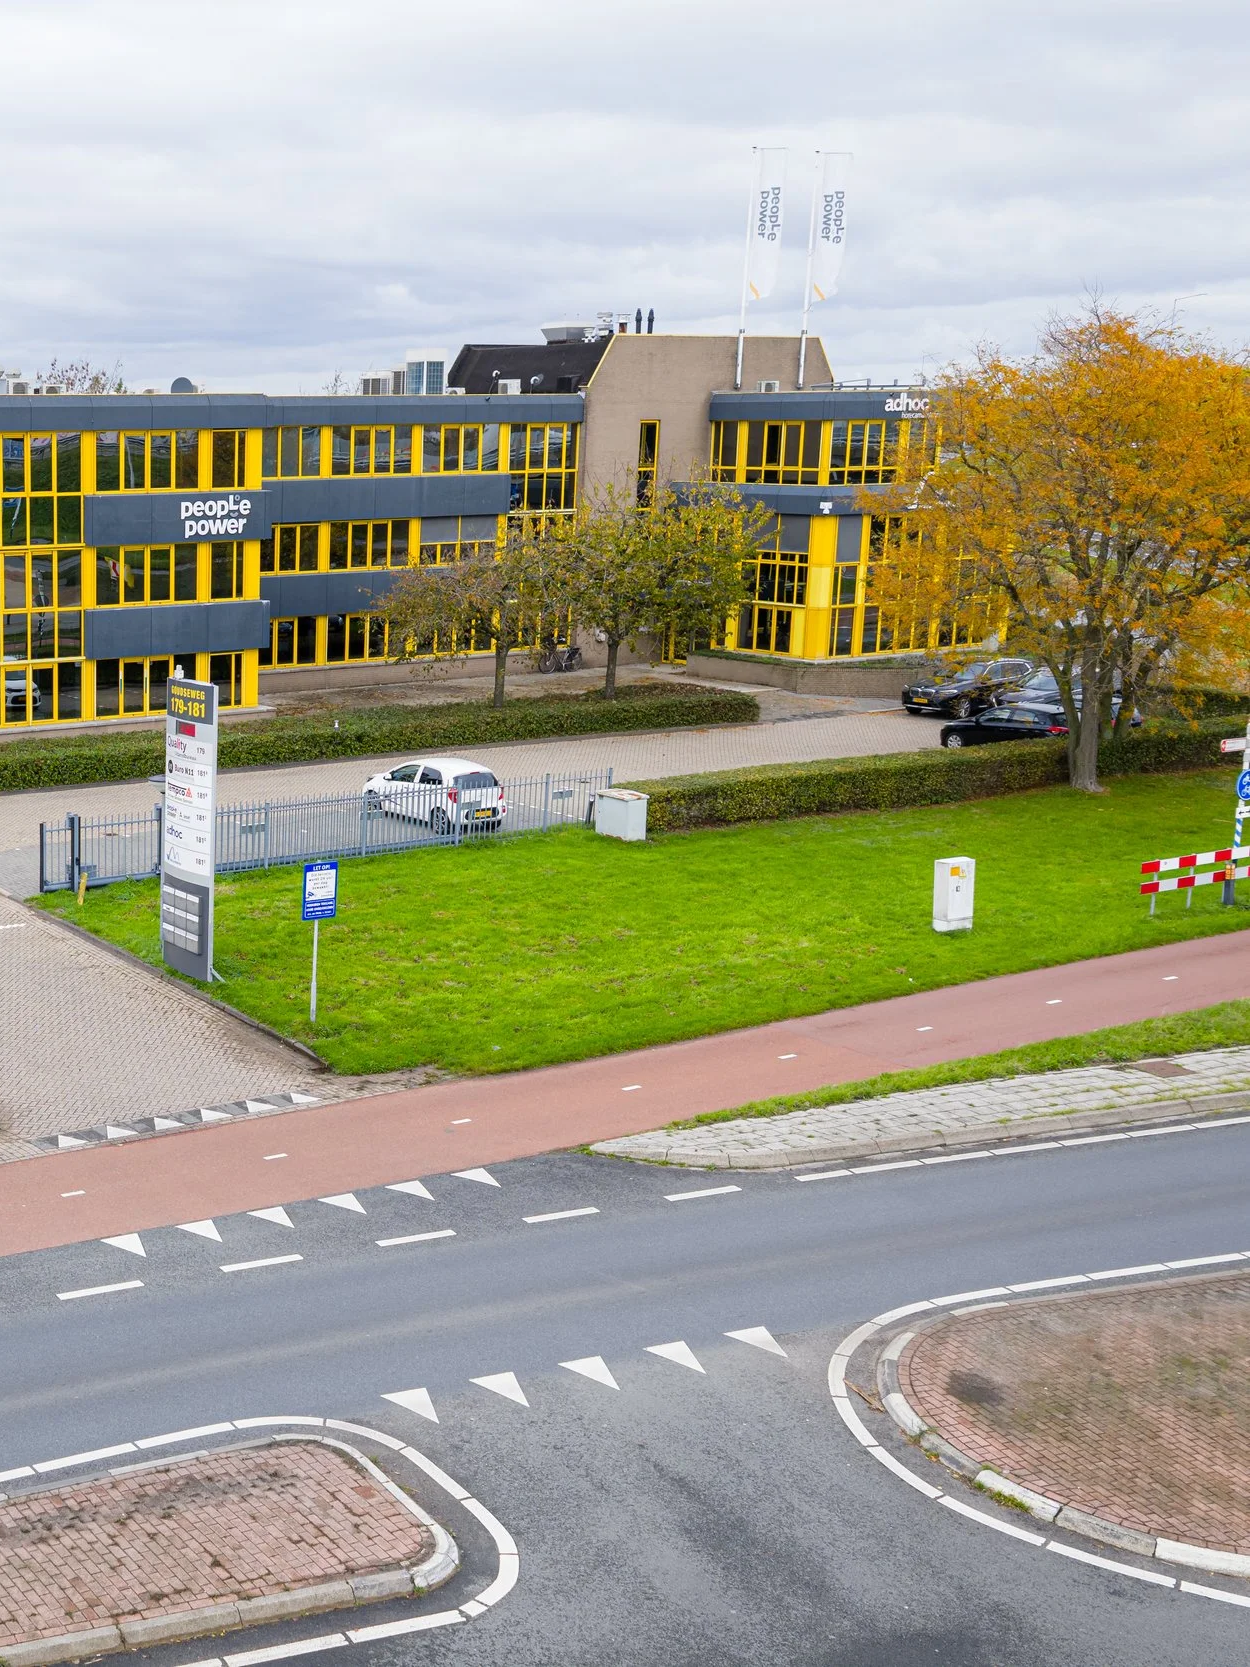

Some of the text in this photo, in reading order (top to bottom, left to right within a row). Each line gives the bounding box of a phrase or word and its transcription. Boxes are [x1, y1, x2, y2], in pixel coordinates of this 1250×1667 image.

[758, 191, 770, 238] power
[821, 194, 834, 241] power
[884, 392, 929, 411] adhoc
[184, 518, 247, 539] power
[171, 697, 205, 718] 179-181
